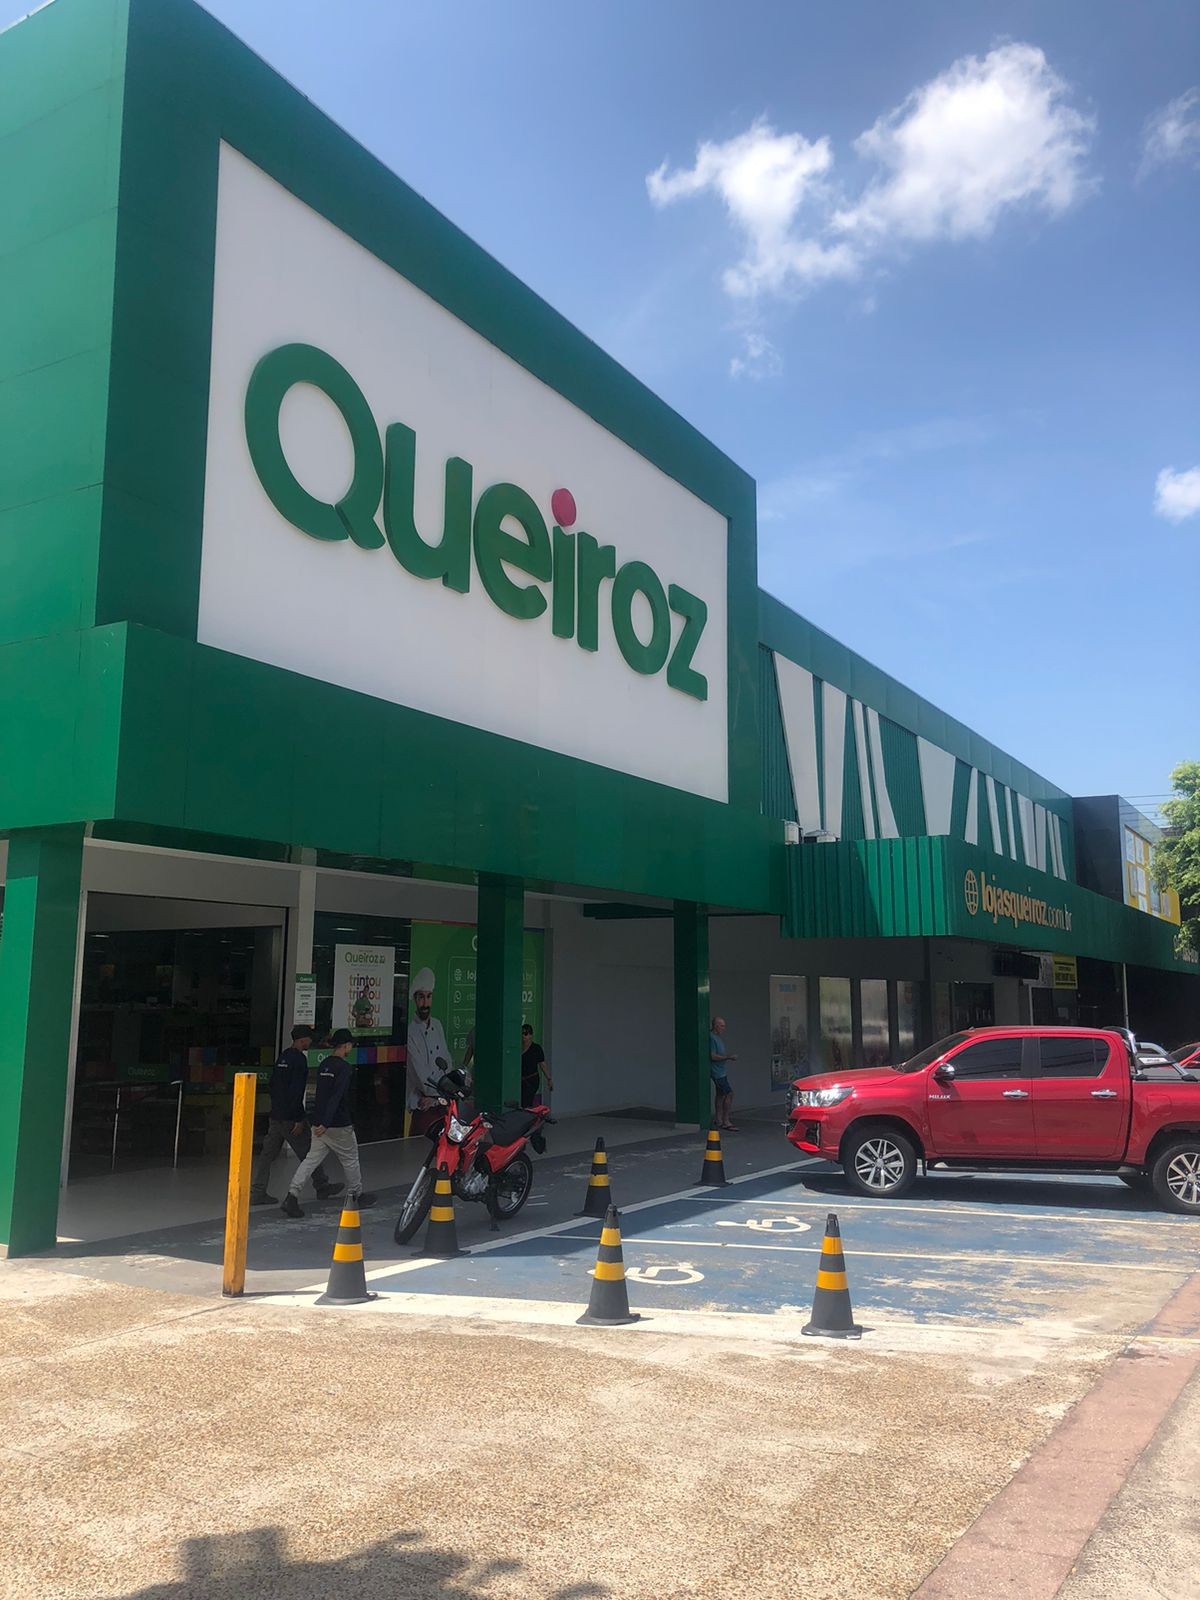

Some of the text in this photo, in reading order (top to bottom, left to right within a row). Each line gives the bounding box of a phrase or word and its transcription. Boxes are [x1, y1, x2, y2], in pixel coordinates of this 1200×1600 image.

[244, 343, 708, 702] Queiroz
[345, 951, 378, 964] Queiroz
[349, 973, 381, 987] trintou
[348, 987, 380, 1000] trinou
